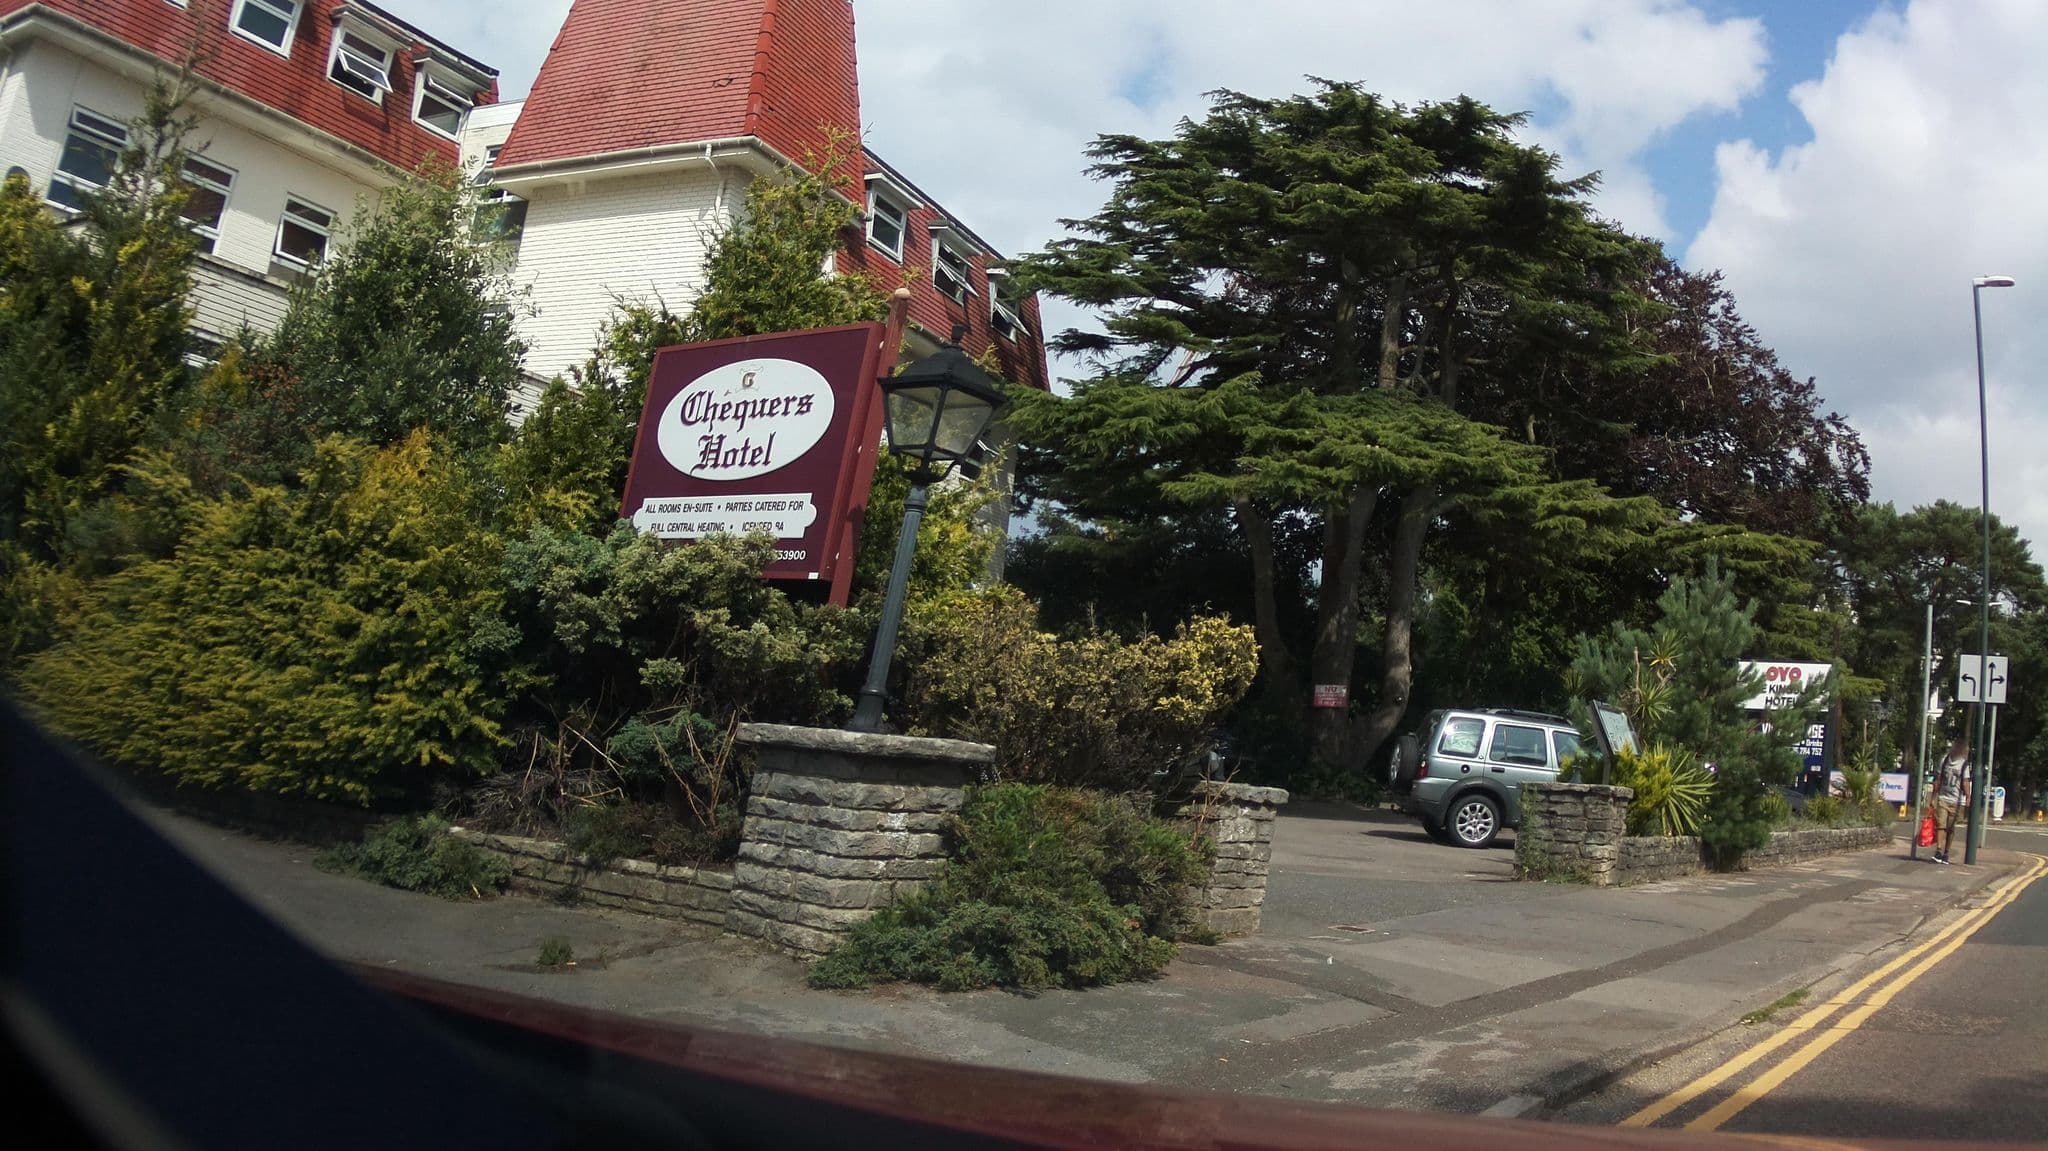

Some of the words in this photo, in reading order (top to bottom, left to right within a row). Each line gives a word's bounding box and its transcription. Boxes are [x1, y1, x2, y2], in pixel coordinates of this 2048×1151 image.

[680, 390, 815, 432] Chequers
[690, 432, 776, 475] Hotel
[645, 504, 657, 514] ALL
[658, 503, 681, 513] ROOMS
[683, 502, 714, 513] EN-SUITE
[725, 501, 752, 512] PARTIES
[755, 500, 786, 512] CATERED
[788, 500, 804, 511] FOR
[650, 522, 665, 532] FULL
[667, 522, 695, 532] CENTRAL
[697, 521, 725, 532] HEATING
[1766, 666, 1802, 682] OYO
